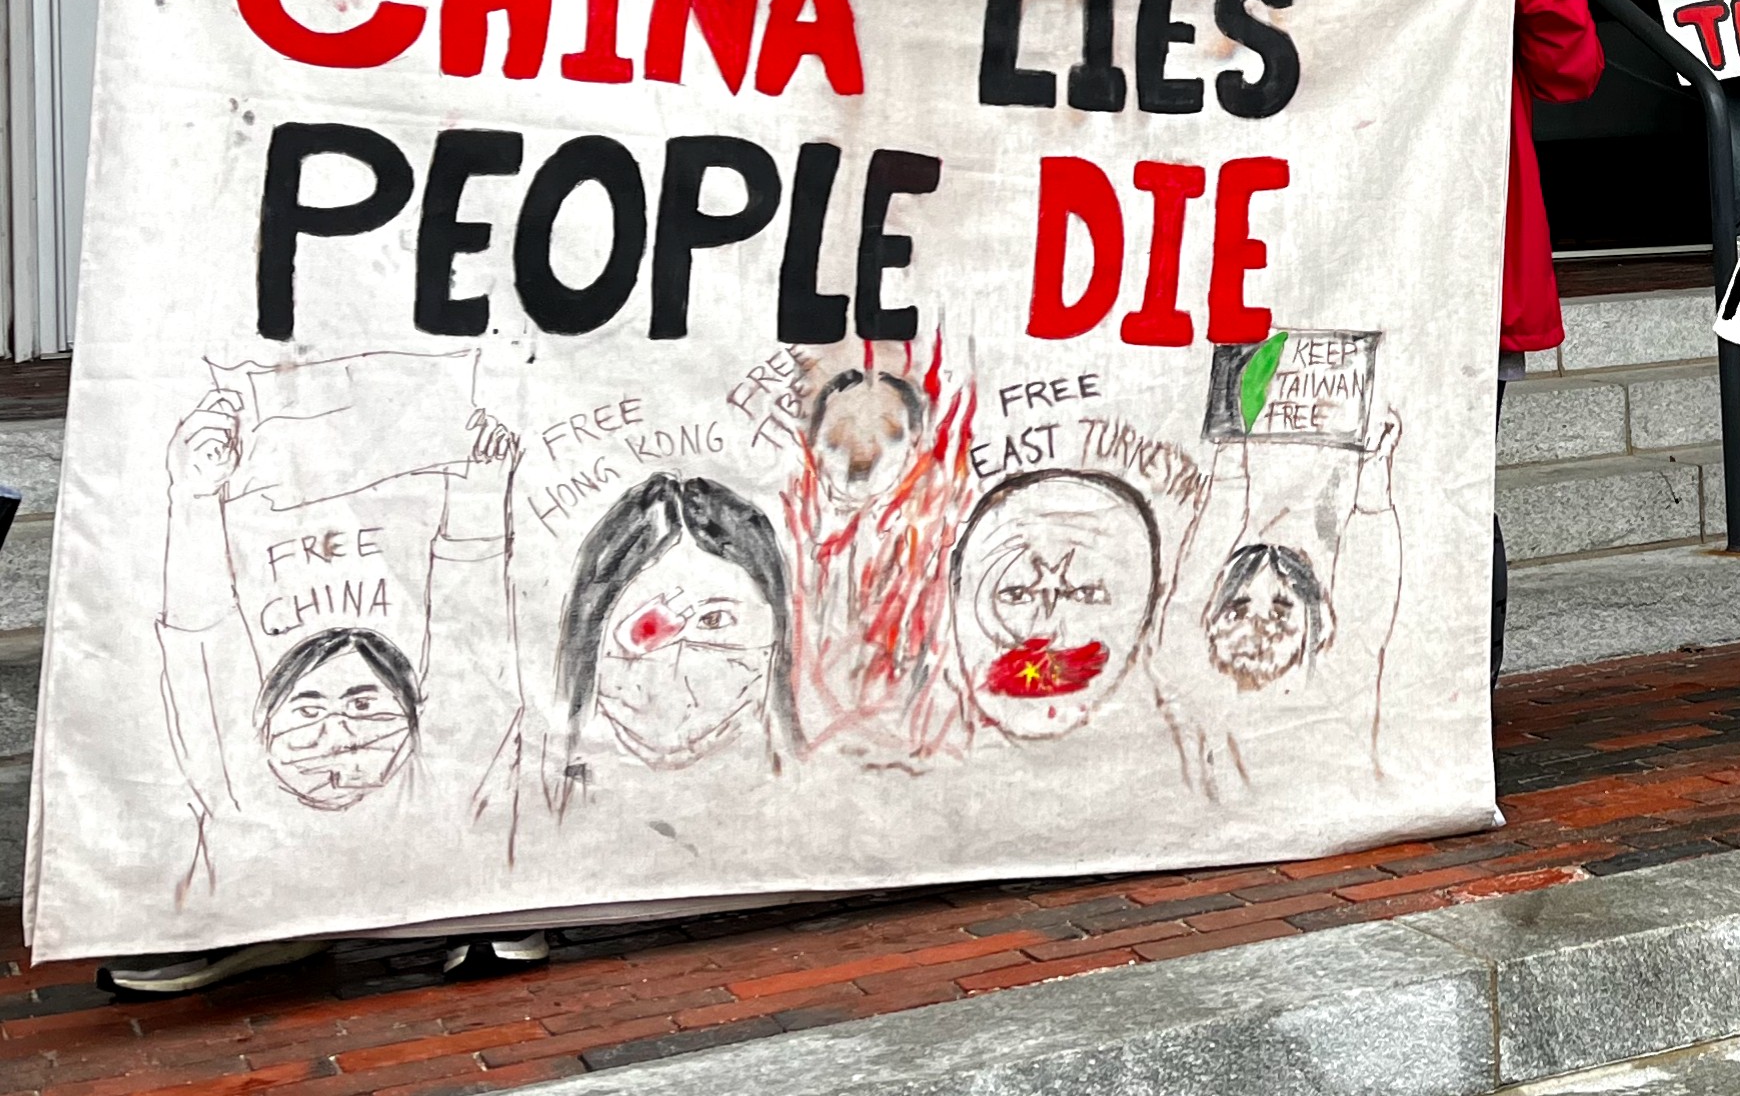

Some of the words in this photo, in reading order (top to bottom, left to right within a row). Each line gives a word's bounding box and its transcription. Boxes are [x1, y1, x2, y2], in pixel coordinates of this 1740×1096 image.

[256, 121, 942, 343] PEOPLE
[1026, 156, 1290, 346] DIE
[1292, 338, 1358, 368] KEEP
[1001, 373, 1101, 417] FREE
[1277, 369, 1365, 399] TAIWAN
[542, 398, 643, 460] FREE
[1264, 401, 1332, 431] FREE
[970, 424, 1061, 478] EAST
[527, 457, 619, 537] HONG
[626, 421, 724, 462] KONG
[268, 528, 384, 582] FREE
[261, 579, 392, 635] CHINA
